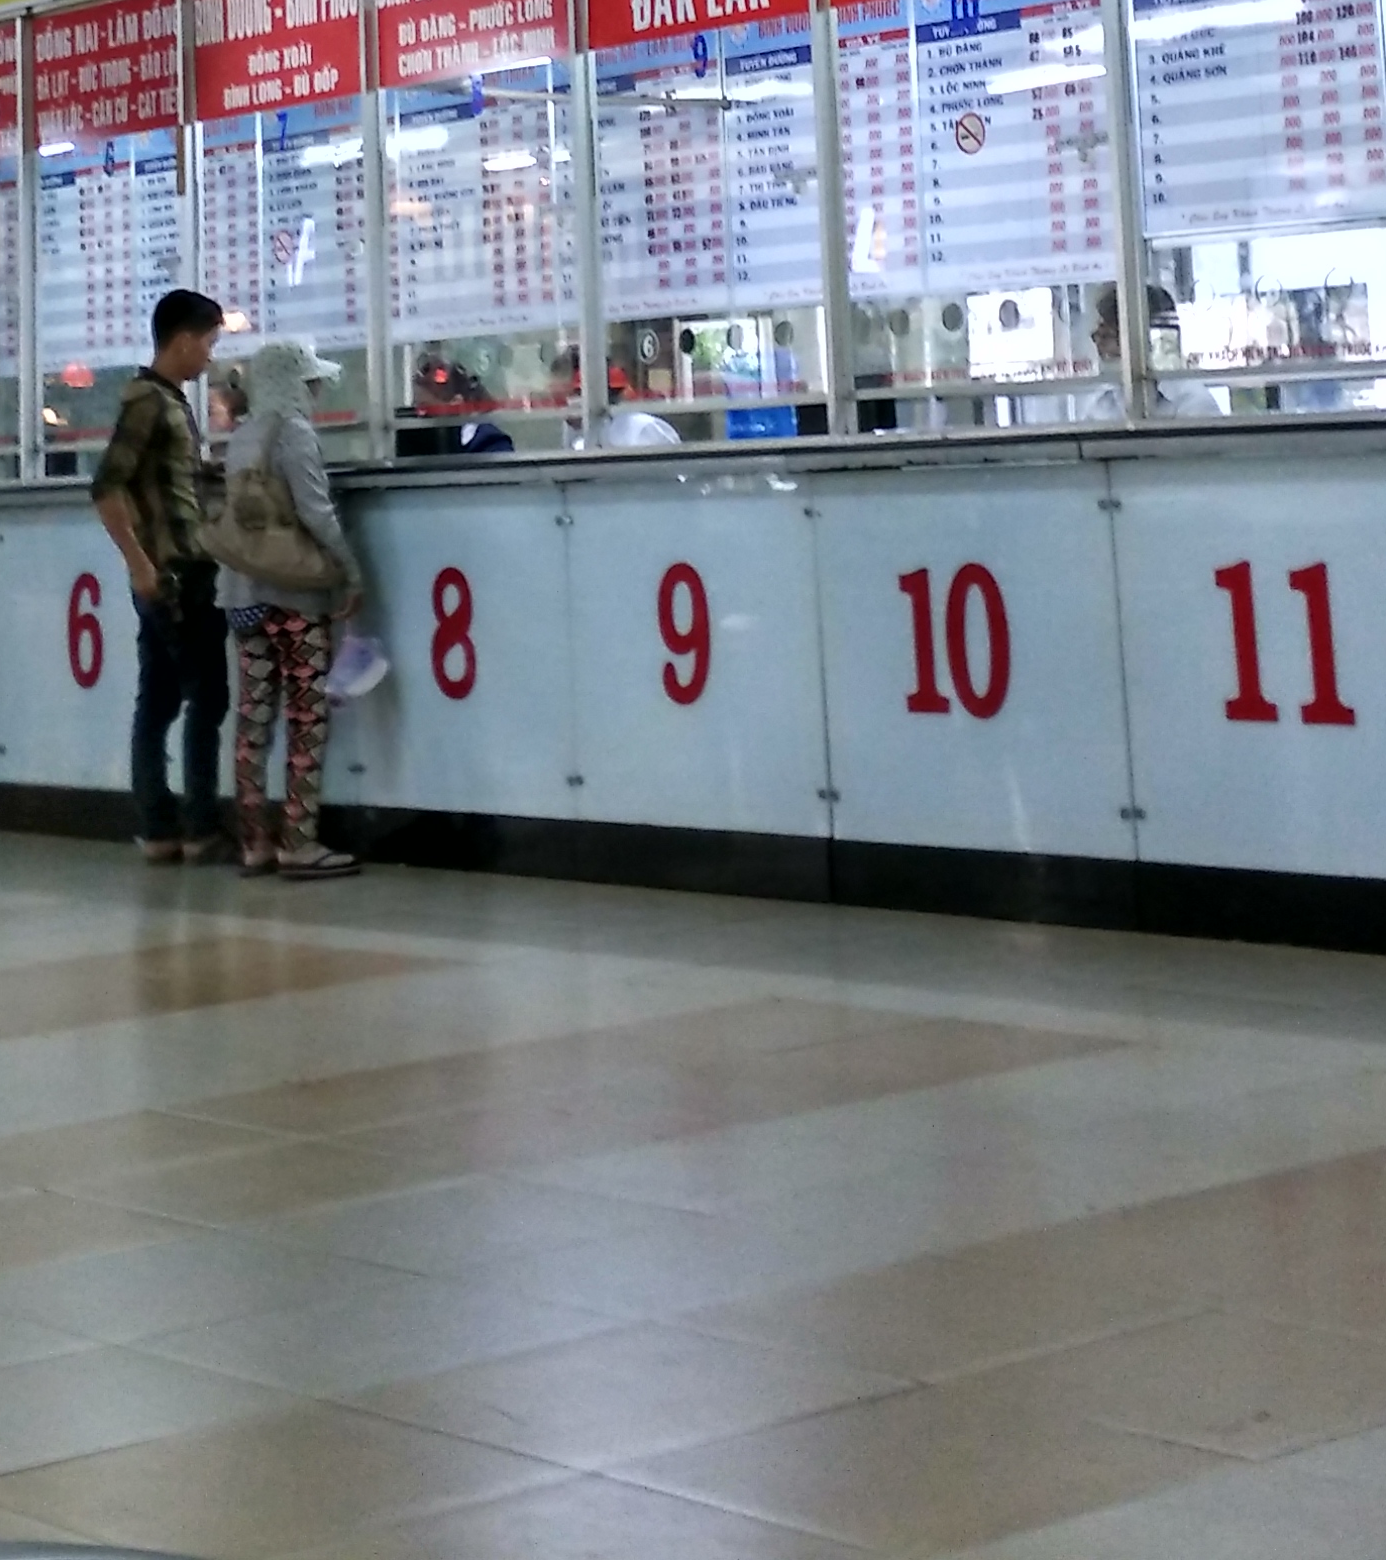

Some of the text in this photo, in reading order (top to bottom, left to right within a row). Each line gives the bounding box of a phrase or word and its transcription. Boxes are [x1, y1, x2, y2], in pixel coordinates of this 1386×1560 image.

[66, 572, 104, 690] 6
[432, 566, 477, 701] 8
[656, 562, 712, 706] 9
[898, 562, 1012, 721] 10
[1214, 560, 1356, 726] 11
